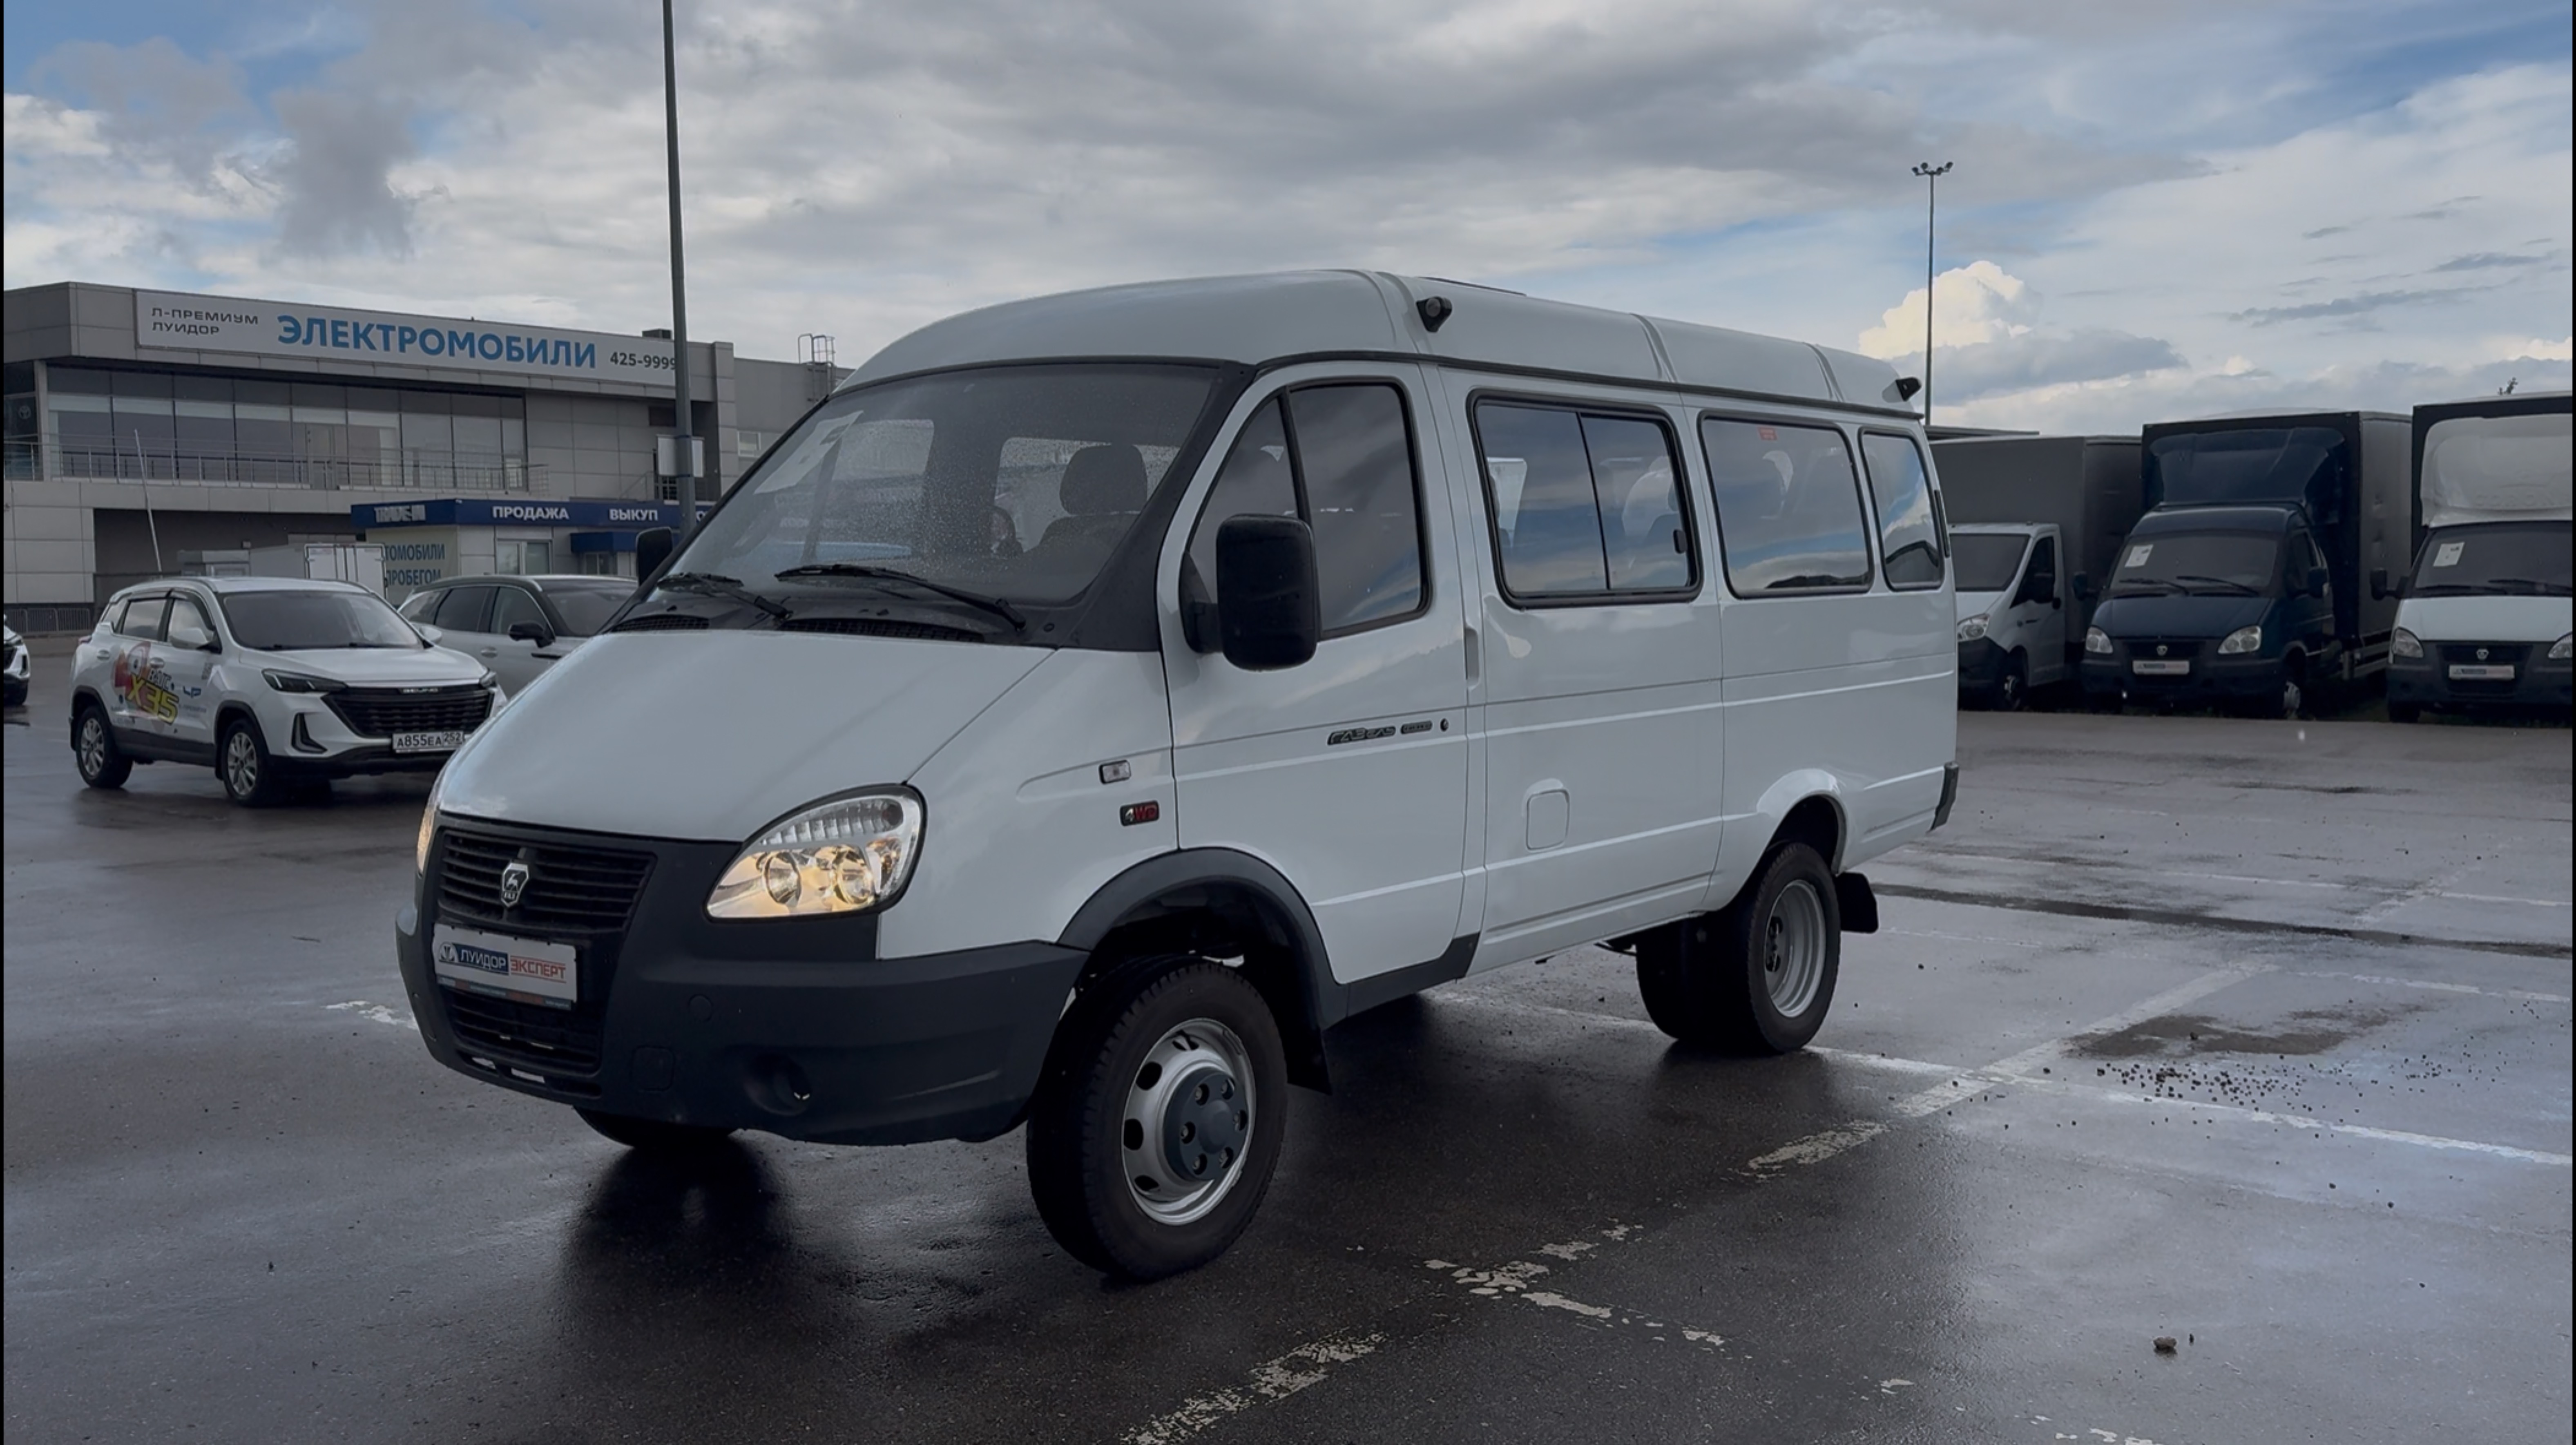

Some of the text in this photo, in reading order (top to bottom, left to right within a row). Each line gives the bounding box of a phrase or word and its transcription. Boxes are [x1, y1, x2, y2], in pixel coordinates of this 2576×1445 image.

[152, 307, 258, 324] Л-ПРЕМИУМ
[152, 322, 220, 335] ЛУИДОР
[277, 315, 596, 368] ЭЛЕКТРОМОБИЛИ
[610, 351, 675, 371] 425-9999
[493, 506, 569, 520] ПРОДАЖА
[609, 509, 659, 521] ВЫКУП
[125, 672, 179, 726] X35
[1125, 804, 1158, 822] 4WD
[460, 949, 566, 979] ЛУИДОР ЭКСПЕРТ
